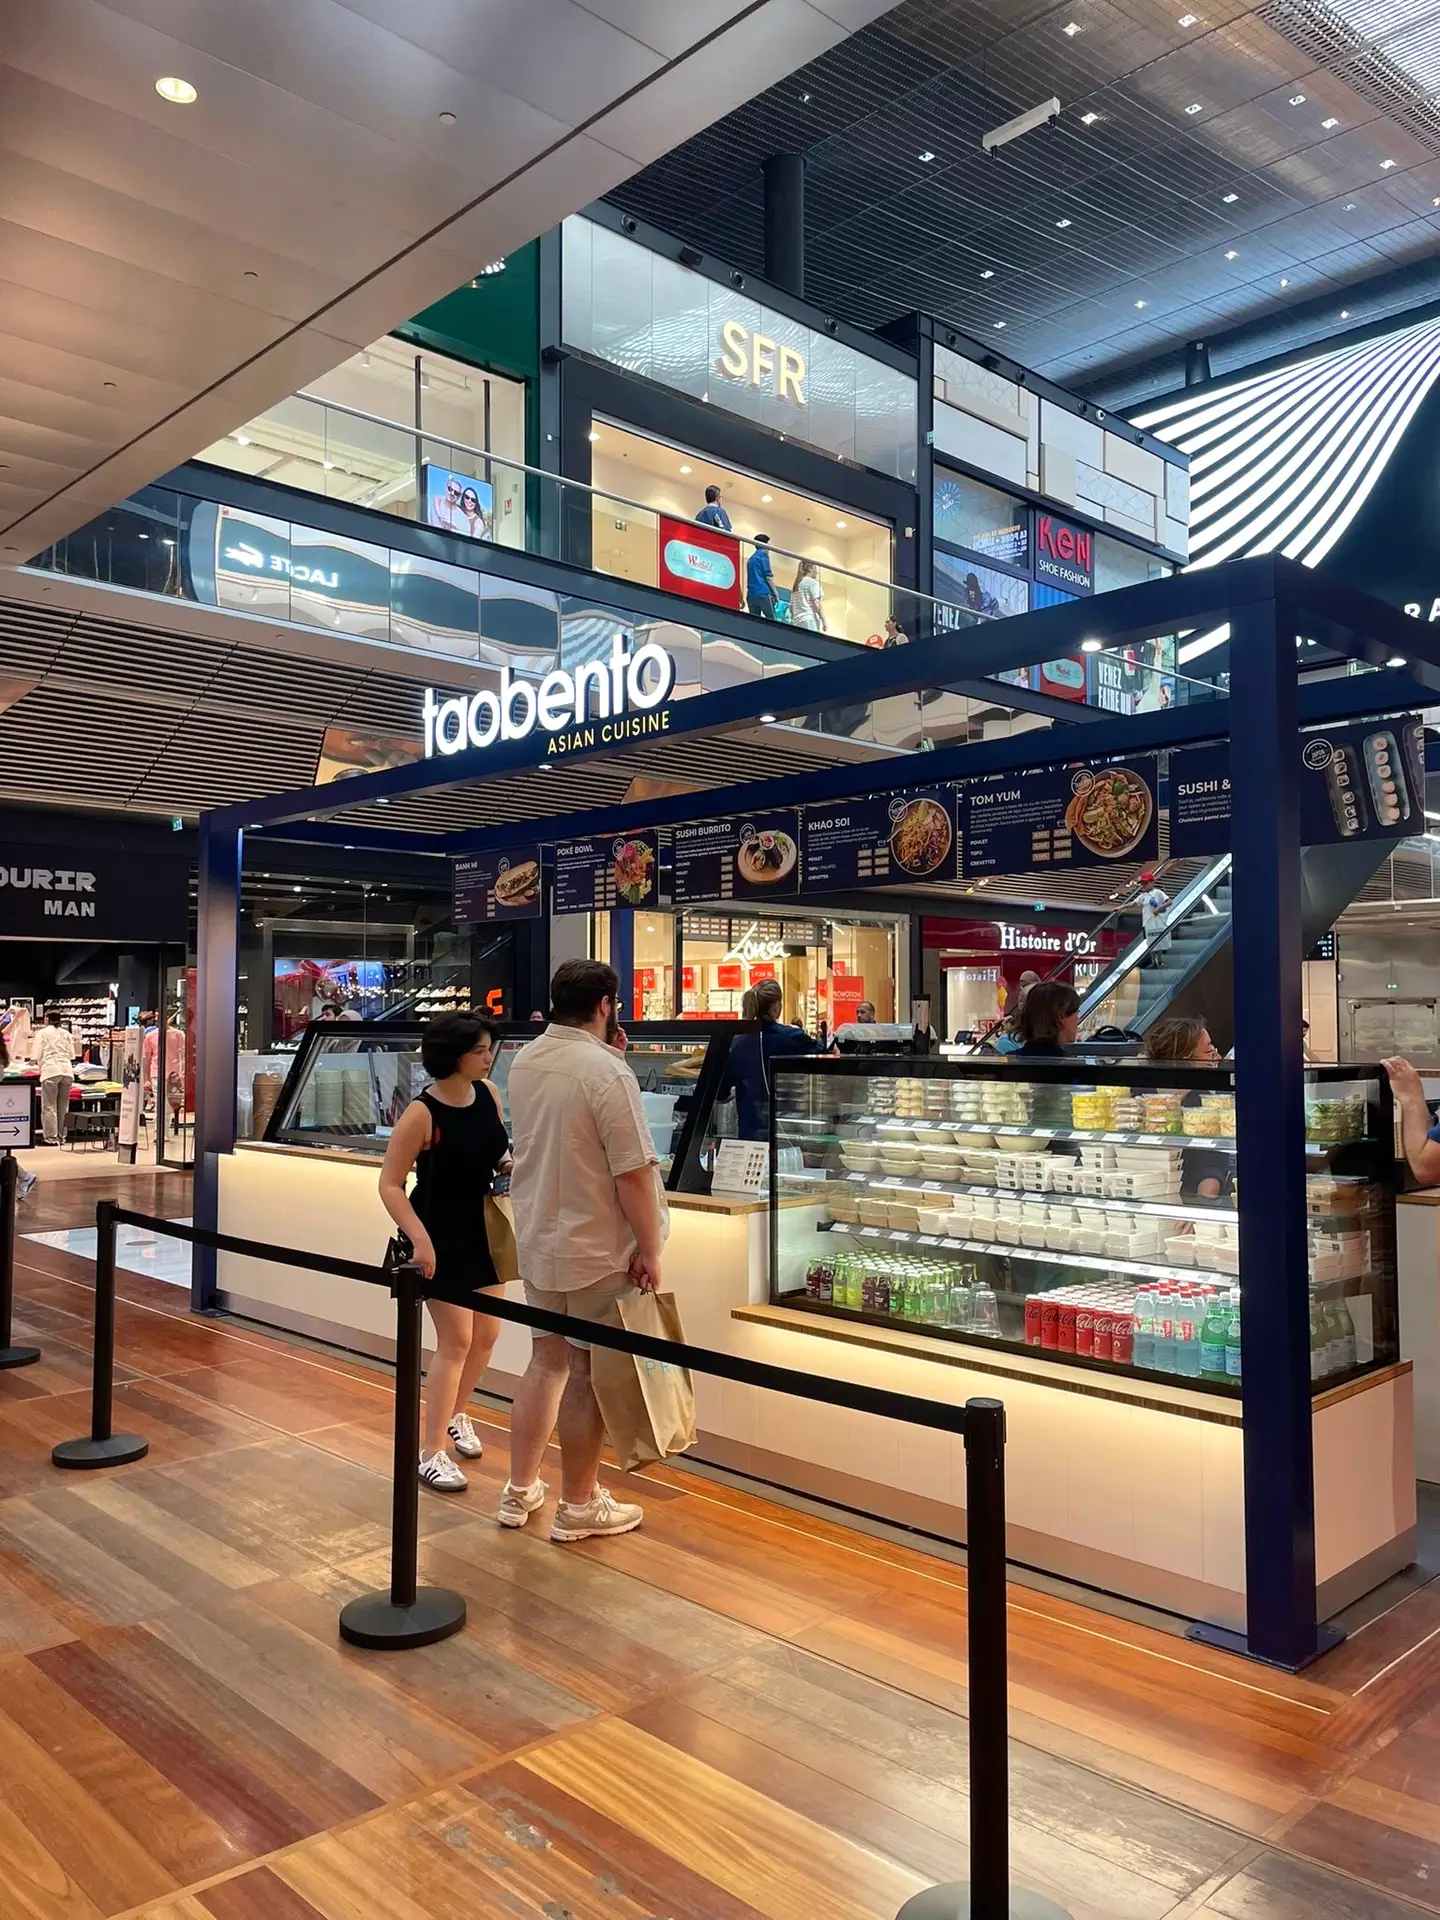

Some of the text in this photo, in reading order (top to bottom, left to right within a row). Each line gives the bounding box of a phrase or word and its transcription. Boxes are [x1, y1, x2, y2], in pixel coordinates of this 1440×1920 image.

[721, 319, 807, 408] SFR
[1039, 559, 1090, 588] SHOE FASHION
[1098, 661, 1122, 690] VENEZ
[422, 633, 674, 759] taobento
[547, 710, 670, 755] ASIAN CUISINE
[970, 790, 1021, 806] TOM YUM
[1178, 778, 1231, 796] SUSHI &
[675, 823, 731, 839] SUSHI BURRITO
[808, 817, 850, 831] KHAO SOI
[556, 844, 594, 856] POKÉ BOWL
[44, 900, 95, 917] MAN
[1000, 926, 1097, 954] Histoire d'Or
